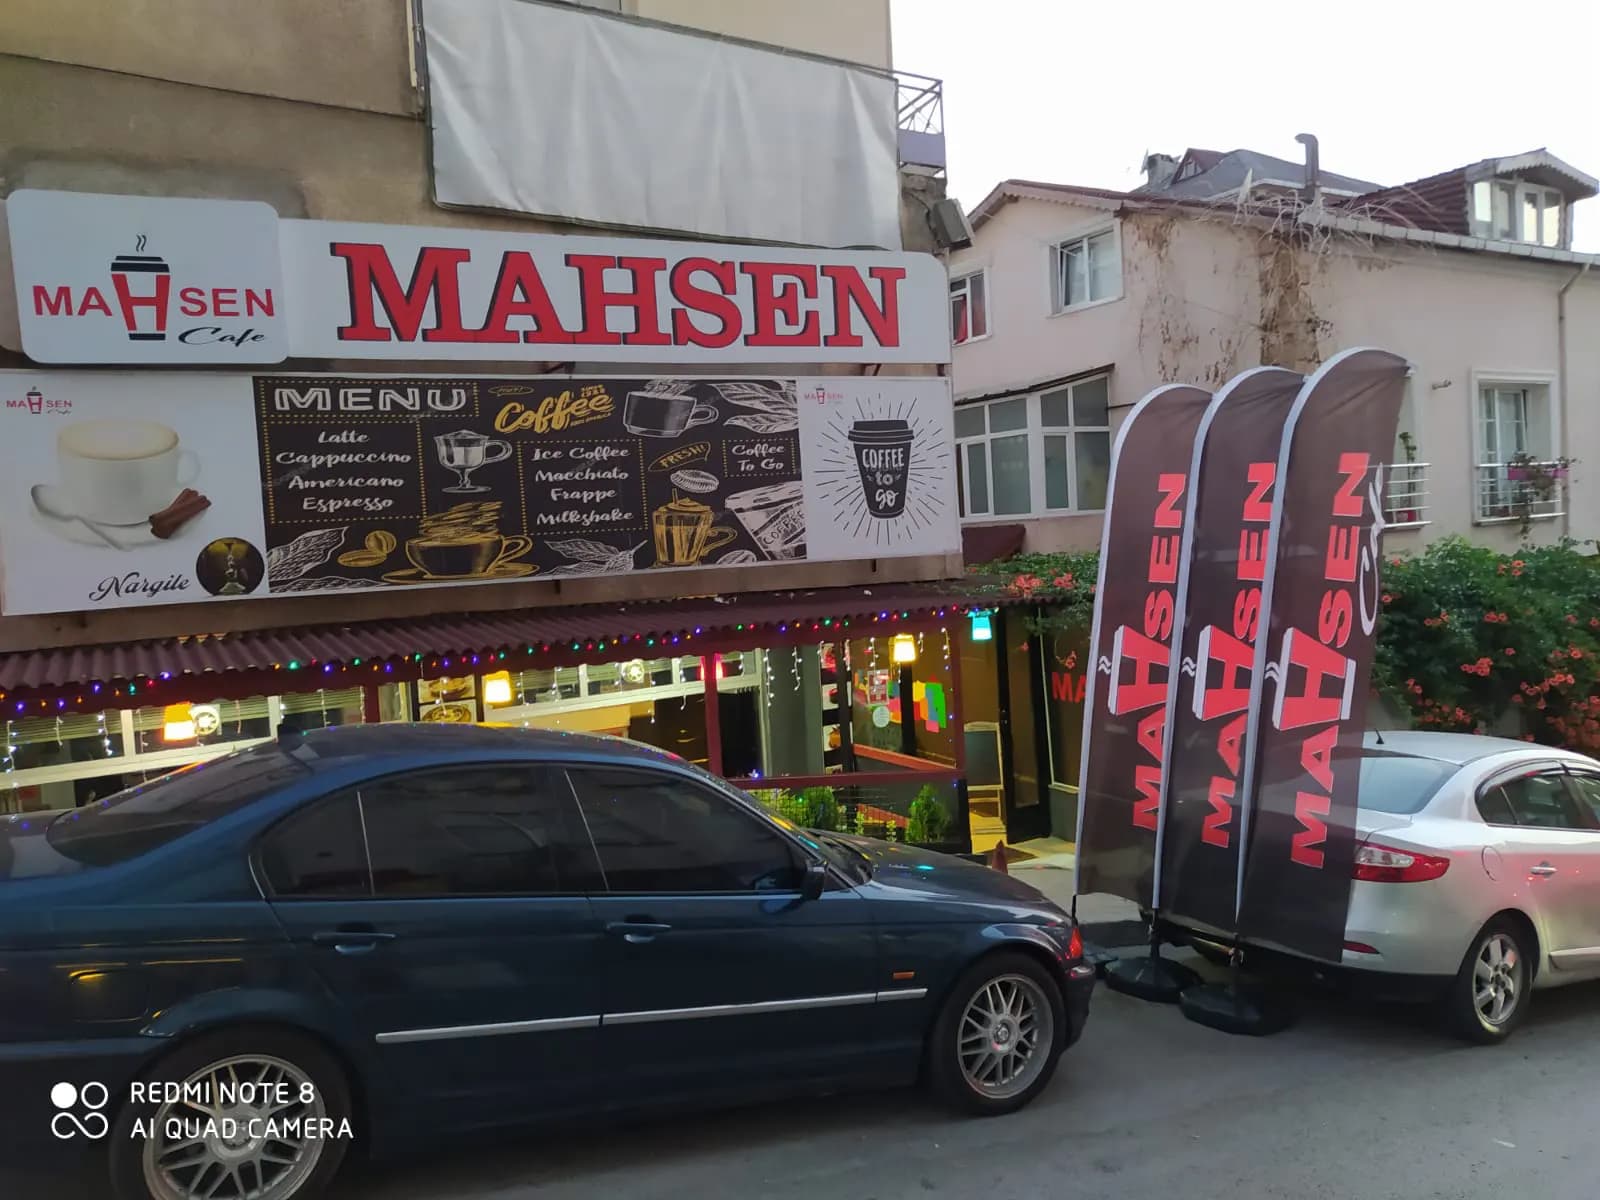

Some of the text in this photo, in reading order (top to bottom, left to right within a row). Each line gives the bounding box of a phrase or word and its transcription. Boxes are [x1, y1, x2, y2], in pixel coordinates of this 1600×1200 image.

[33, 272, 275, 332] MAHSEN
[330, 241, 906, 350] MAHSEN
[178, 326, 265, 347] Cafe
[6, 396, 73, 412] MAHSEN
[274, 387, 467, 412] MENU
[494, 390, 614, 434] Coffee
[318, 429, 370, 444] Latte
[275, 451, 412, 469] Cappuccino
[530, 445, 631, 462] Ice Coffee
[731, 443, 785, 458] Coffee
[862, 447, 905, 469] COFFEE
[737, 458, 784, 471] To Go
[288, 475, 405, 490] Americano
[875, 471, 894, 486] to
[302, 496, 395, 513] Espresso
[550, 487, 617, 503] Frappe
[875, 488, 900, 510] go
[536, 508, 634, 527] Milkshake
[88, 571, 190, 602] Nargile
[1115, 473, 1187, 832] MAHSEN
[1201, 462, 1276, 848] MAHSEN
[1280, 452, 1372, 869] MAHSEN
